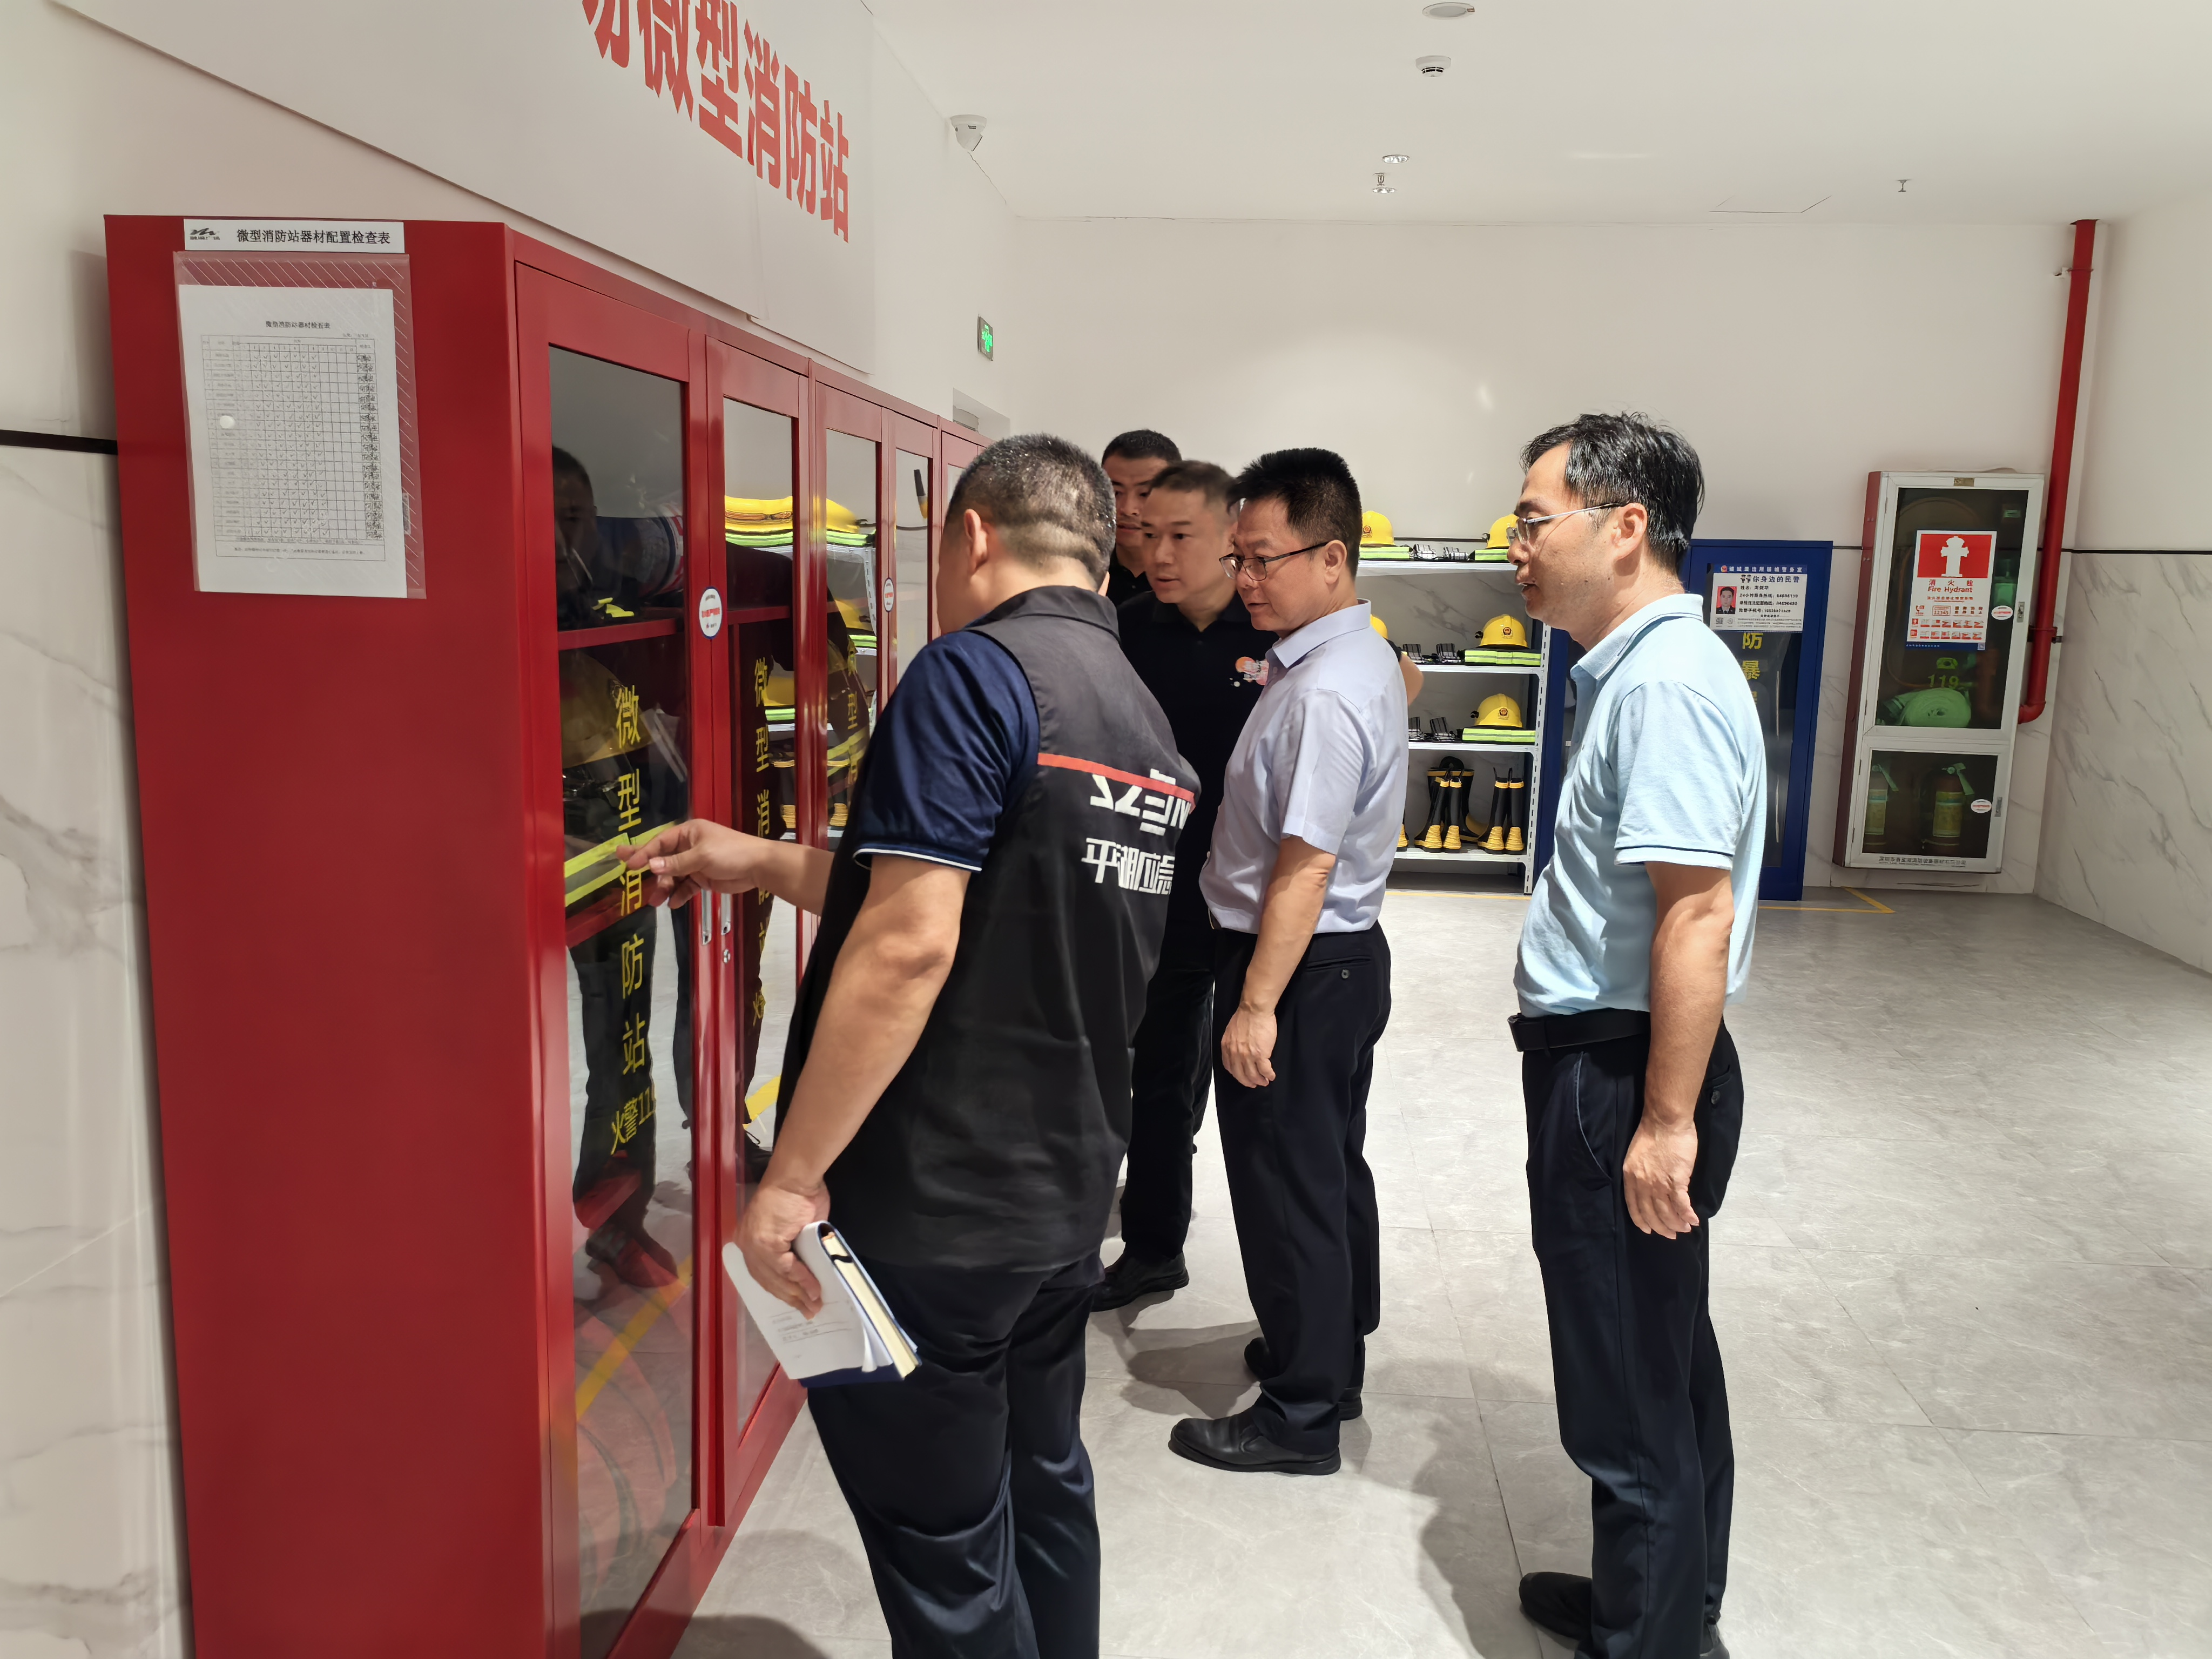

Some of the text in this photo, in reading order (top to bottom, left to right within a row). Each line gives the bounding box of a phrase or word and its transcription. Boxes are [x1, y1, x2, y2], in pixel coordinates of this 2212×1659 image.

[237, 229, 390, 245] 微型消防站器材配置检查表
[1742, 632, 1764, 705] 防暴
[616, 685, 646, 1075] 微型消防站
[610, 1086, 656, 1155] 火警11
